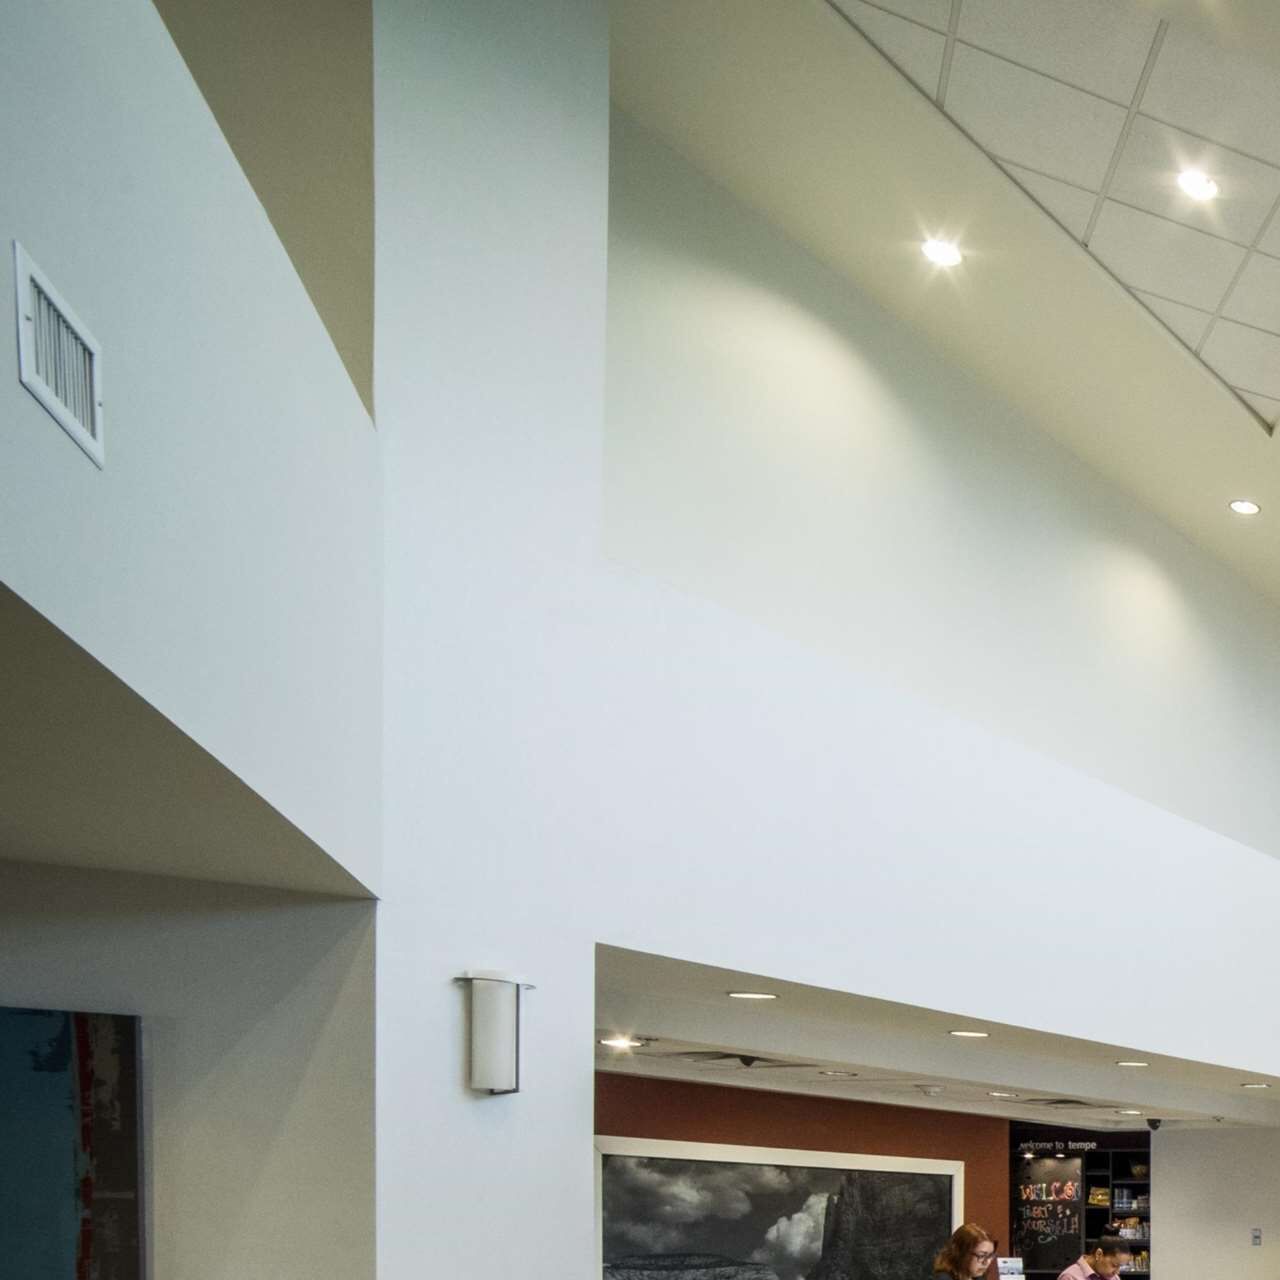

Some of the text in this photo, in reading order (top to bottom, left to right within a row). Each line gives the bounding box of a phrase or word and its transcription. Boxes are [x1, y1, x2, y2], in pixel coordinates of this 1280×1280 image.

[1019, 1140, 1097, 1151] welcome to tempe
